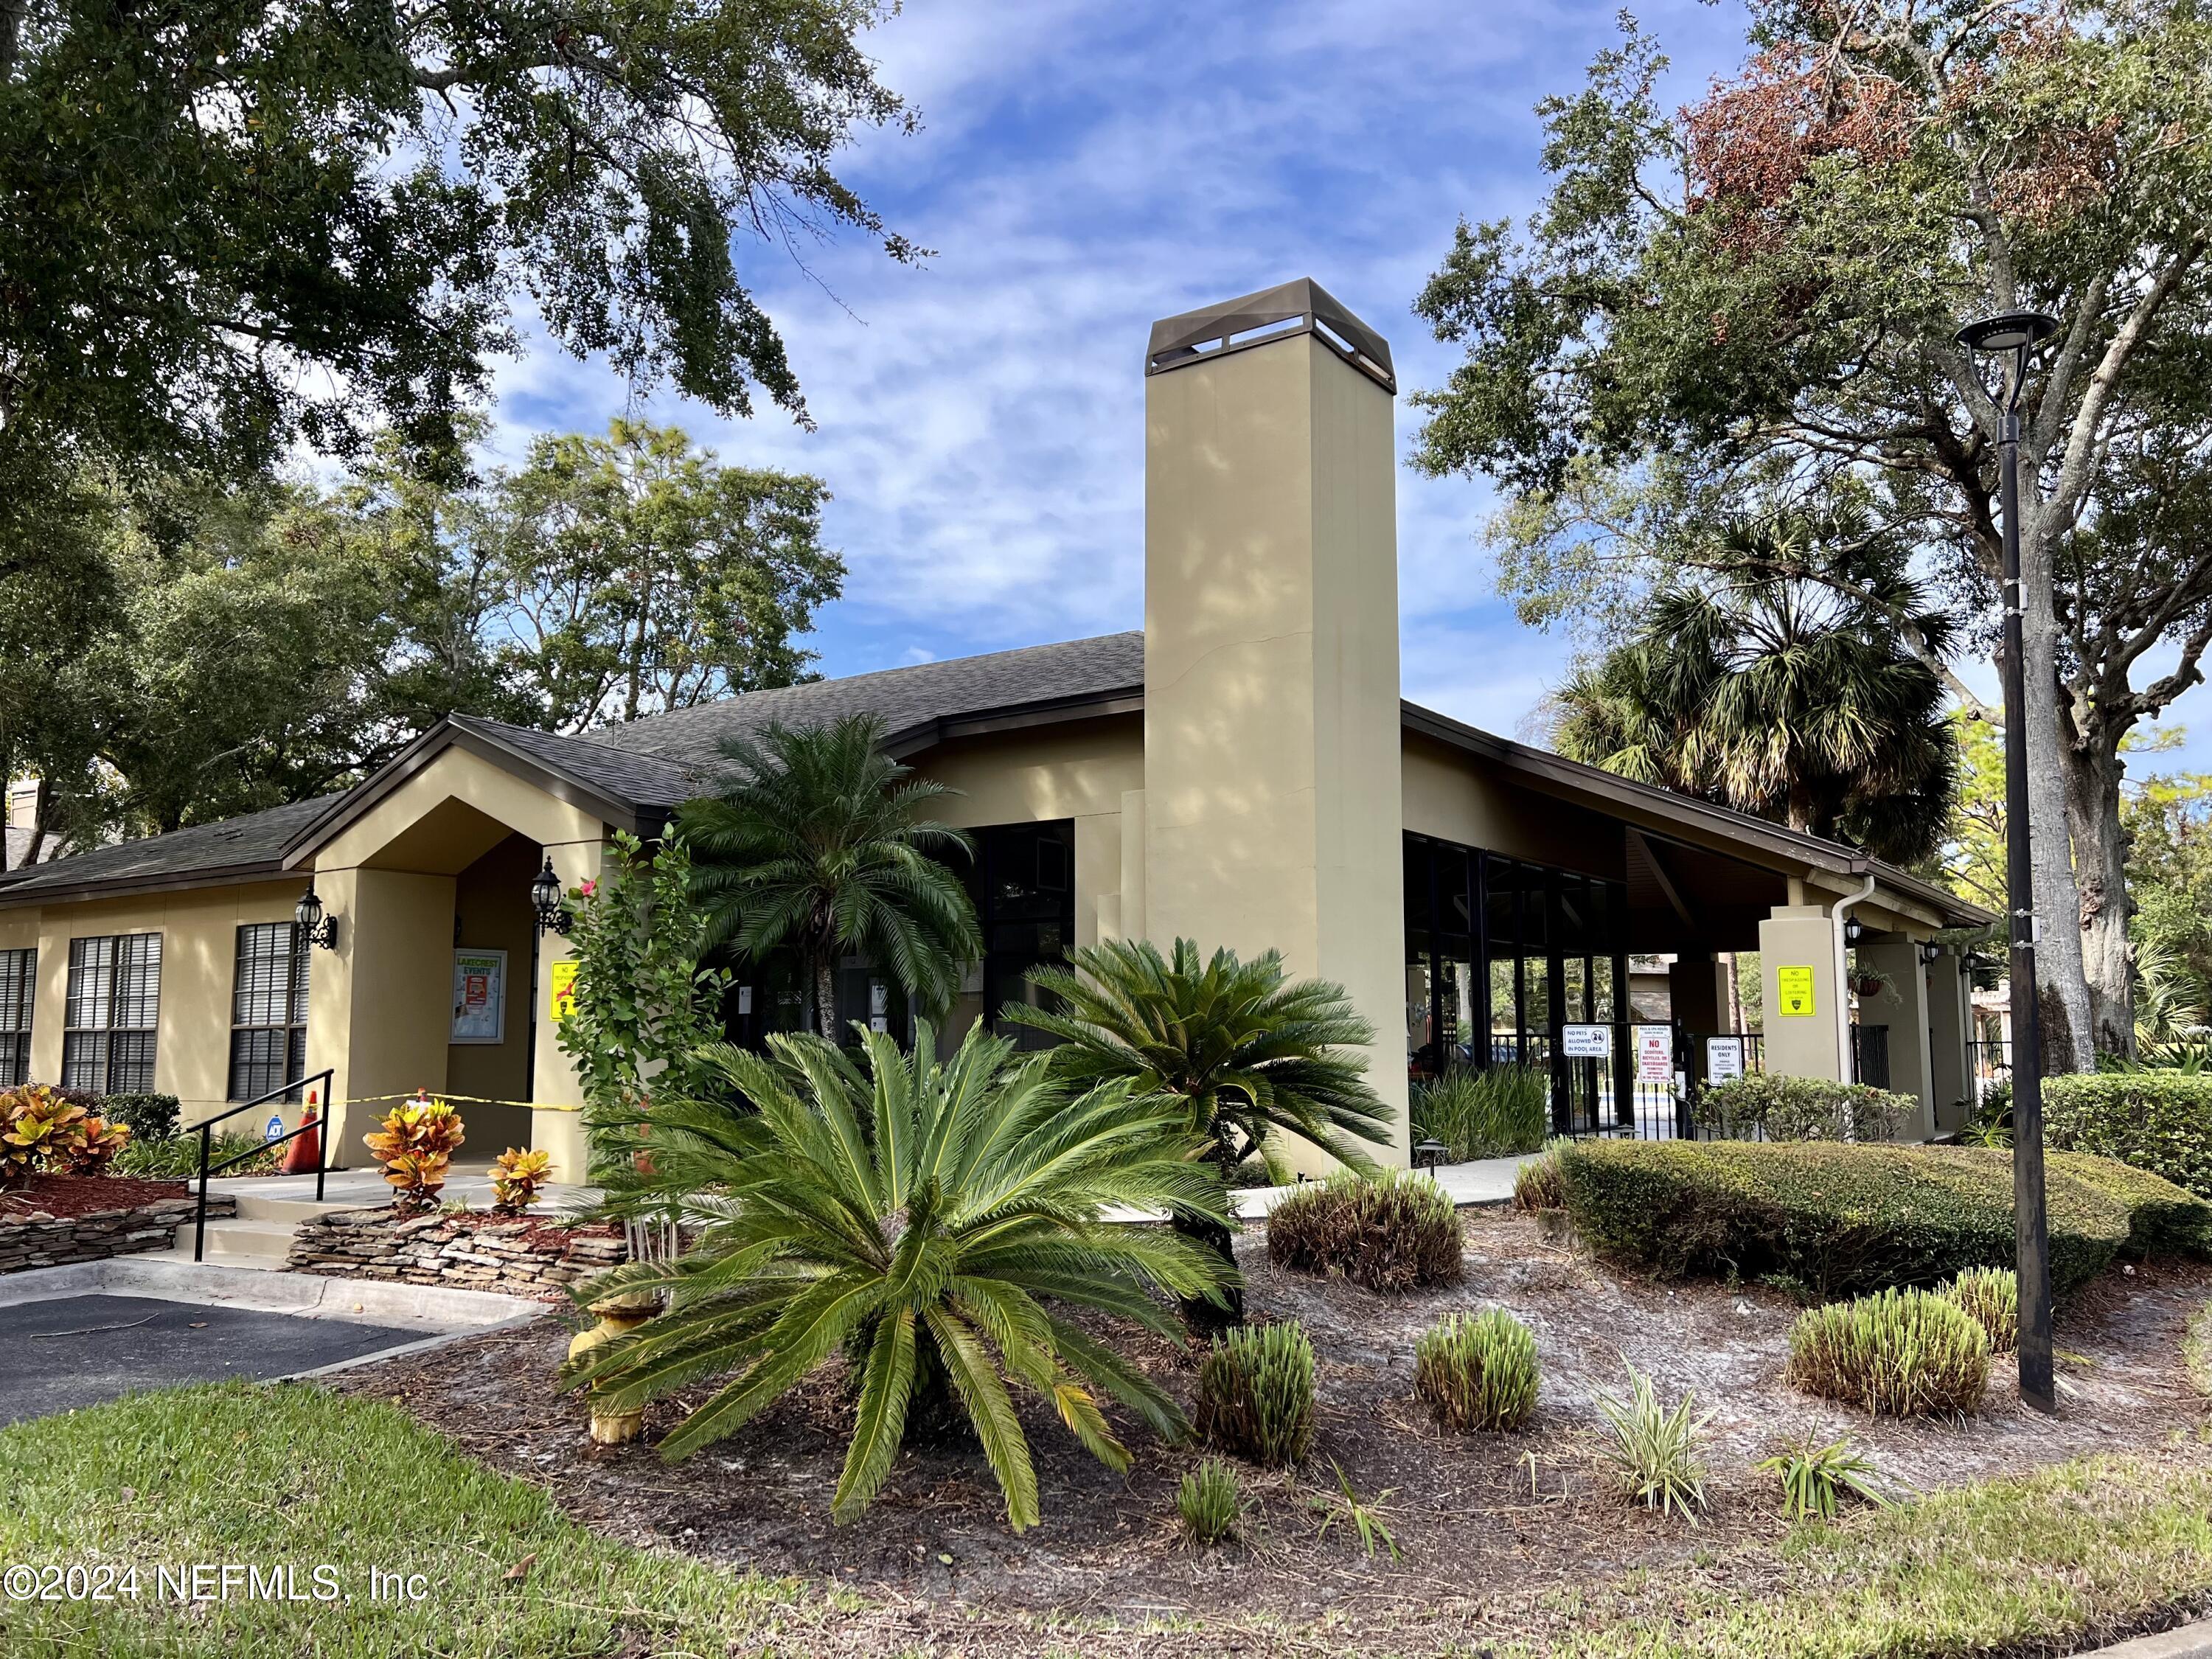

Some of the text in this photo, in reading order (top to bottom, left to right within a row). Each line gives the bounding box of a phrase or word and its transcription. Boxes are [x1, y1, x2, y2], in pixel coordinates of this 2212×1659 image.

[457, 958, 498, 967] LAKECREST
[464, 967, 490, 975] EVENTS
[268, 1124, 282, 1136] ADT
